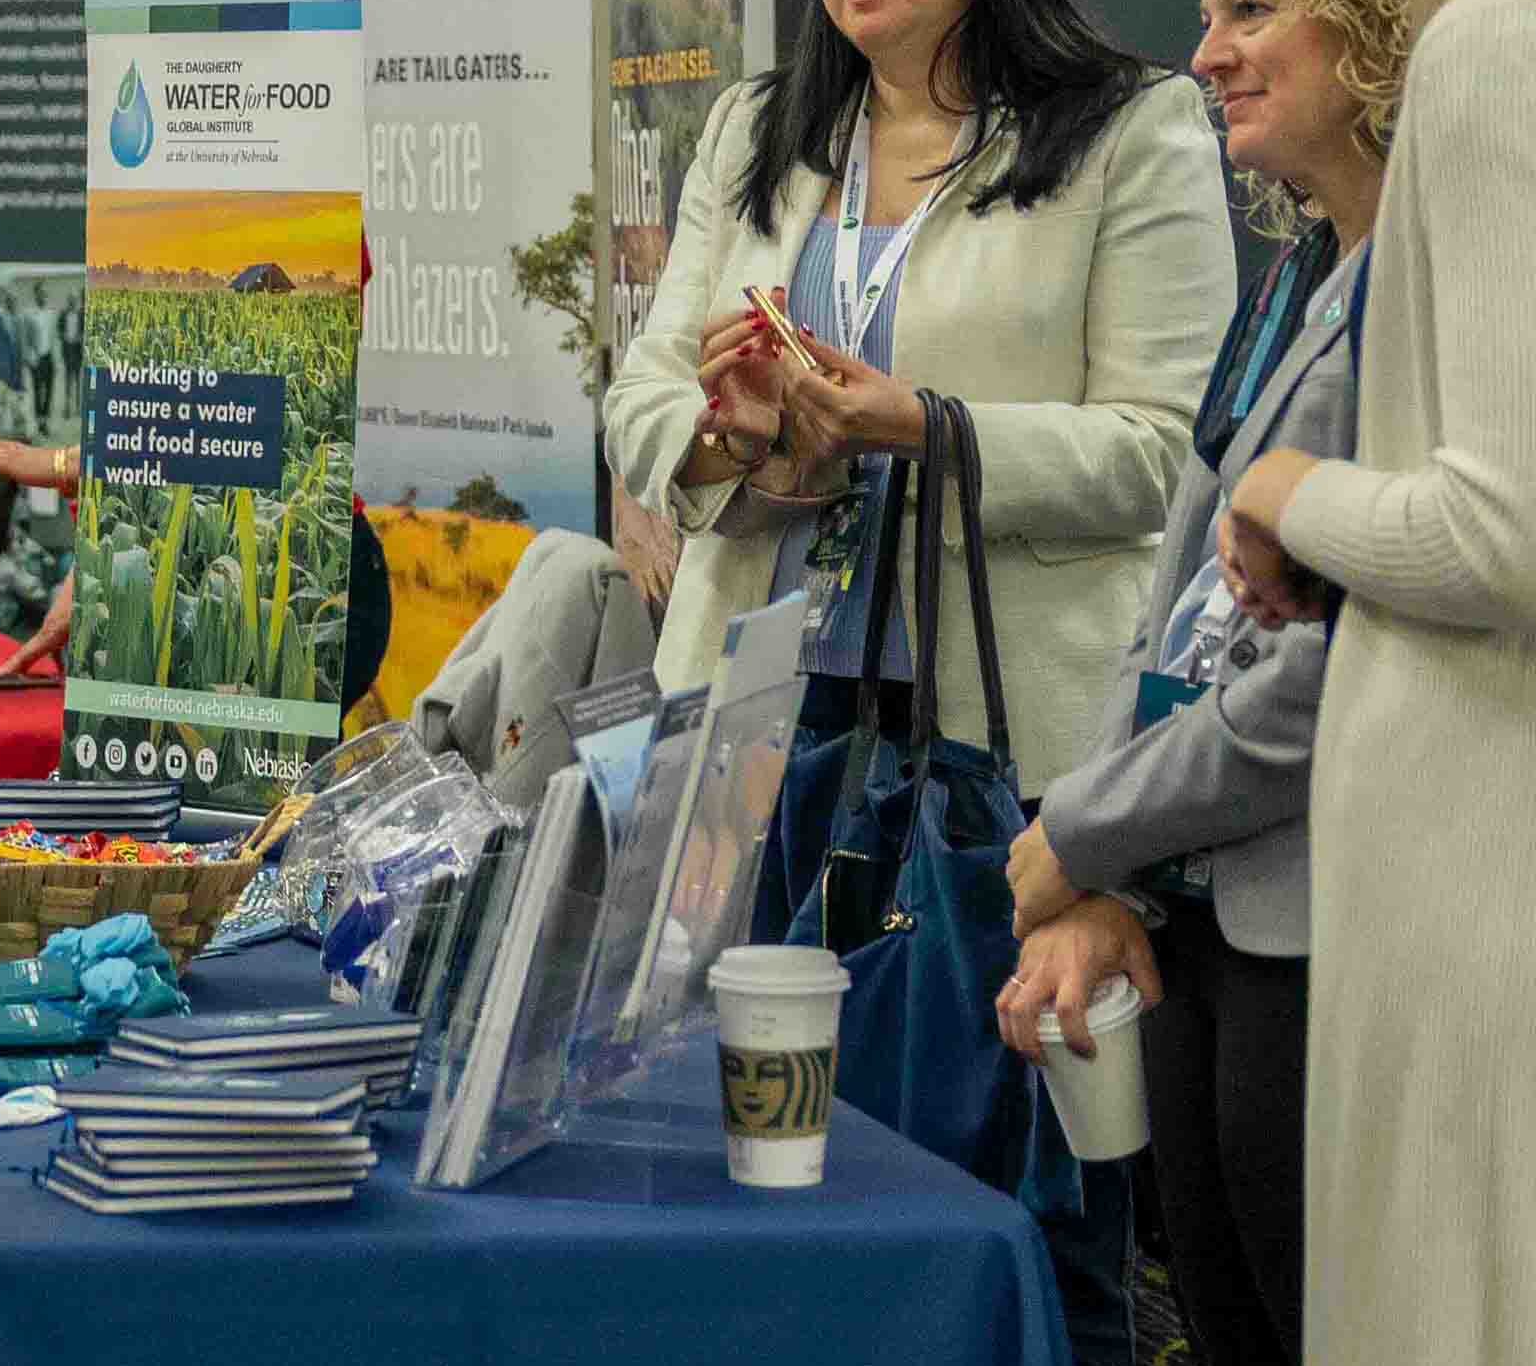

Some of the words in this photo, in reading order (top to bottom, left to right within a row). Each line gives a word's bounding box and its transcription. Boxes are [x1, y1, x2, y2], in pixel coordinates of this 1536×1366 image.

[165, 63, 183, 74] THE
[185, 61, 243, 74] DAUGHERTY
[375, 58, 408, 83] ARE
[412, 54, 549, 82] TAILGATERS...
[165, 84, 239, 110] WATER
[266, 83, 330, 110] FOOD
[166, 121, 205, 133] GLOBAL
[206, 120, 253, 133] INSTITUTE
[372, 122, 416, 213] ers
[429, 122, 481, 213] are
[109, 360, 192, 394] Working
[197, 366, 218, 388] to
[107, 400, 172, 421] ensure
[177, 406, 191, 421] a
[196, 403, 257, 425] water
[106, 432, 143, 453] and
[148, 432, 195, 456] food
[199, 439, 264, 461] secure
[104, 462, 168, 487] world.
[109, 694, 284, 724] waterforfood.nebraska.edu
